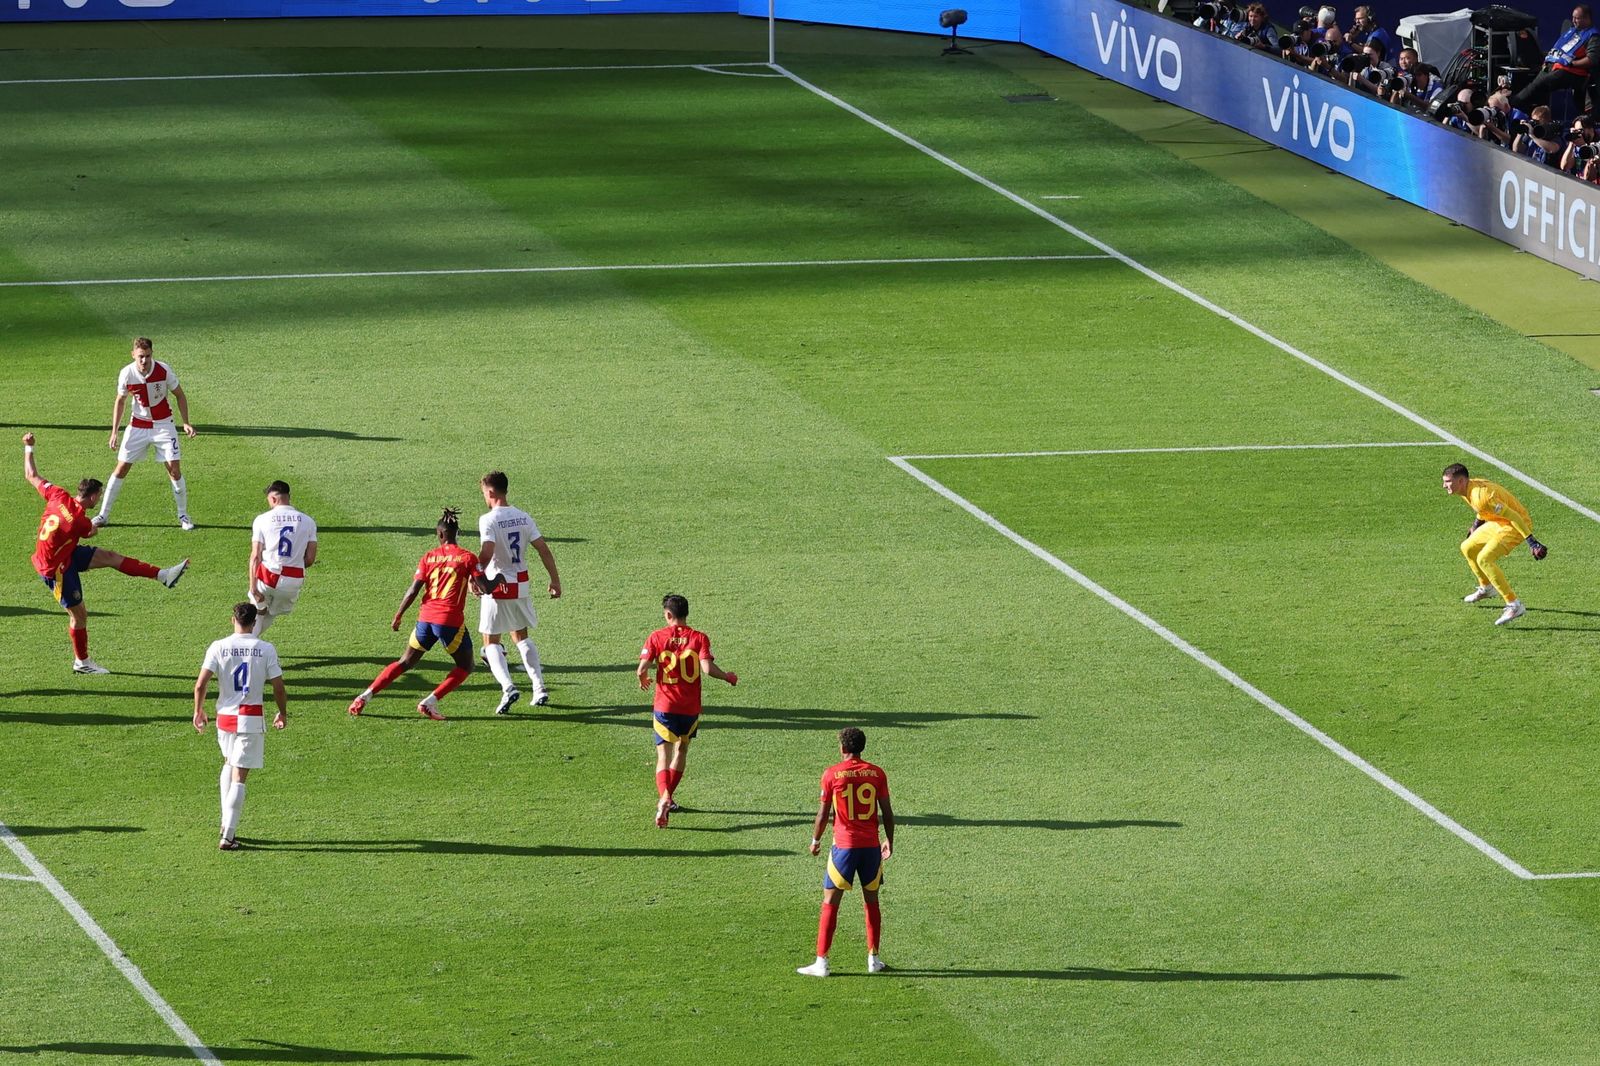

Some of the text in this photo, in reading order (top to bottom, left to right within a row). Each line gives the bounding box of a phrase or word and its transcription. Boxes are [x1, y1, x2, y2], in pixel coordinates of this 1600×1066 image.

[1091, 8, 1182, 91] vivo
[1262, 74, 1355, 162] vivo
[1499, 170, 1600, 266] OFFICI
[171, 437, 178, 450] 2
[39, 514, 59, 541] 8
[278, 526, 294, 557] 6
[507, 531, 520, 564] 3
[429, 566, 457, 600] 17
[658, 649, 701, 685] 20
[841, 782, 877, 821] 19
